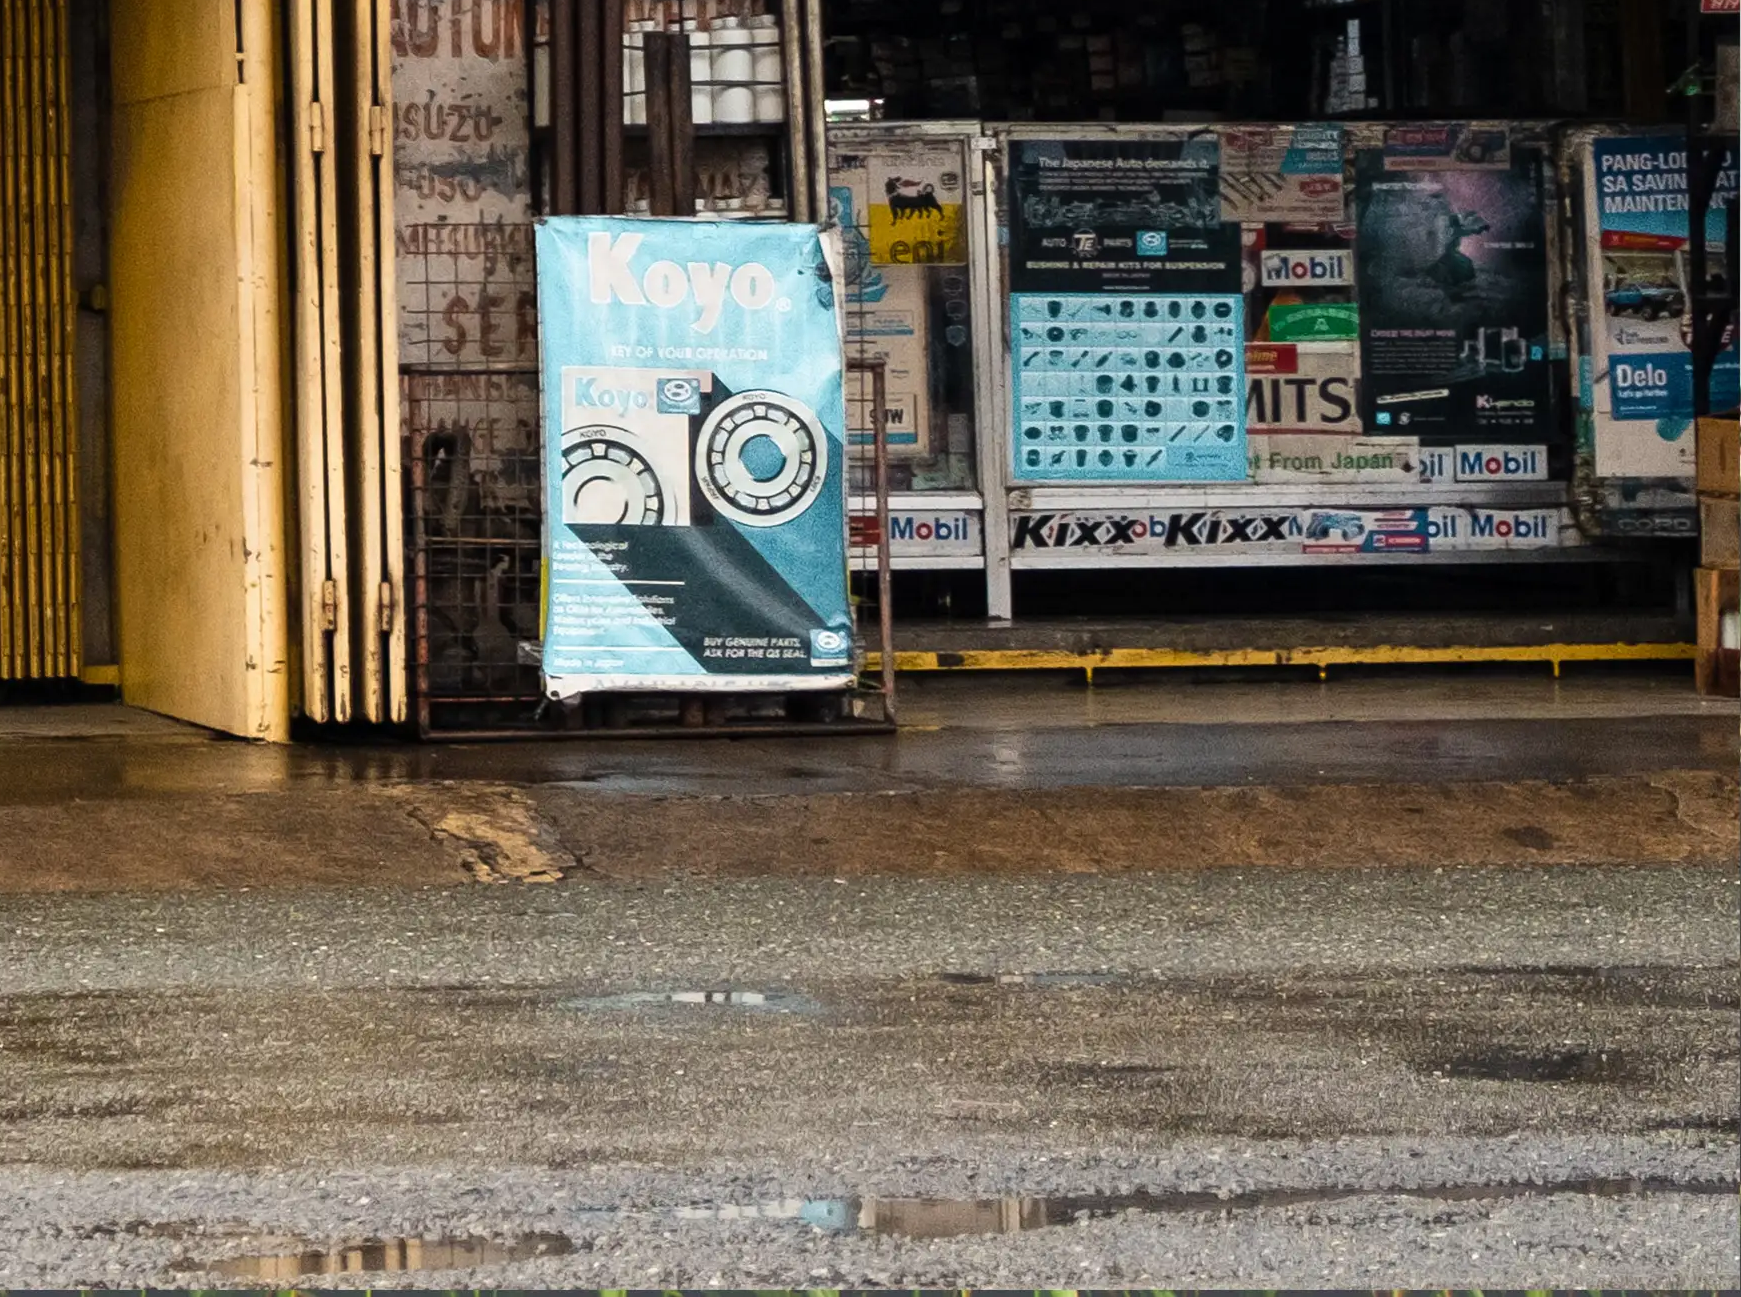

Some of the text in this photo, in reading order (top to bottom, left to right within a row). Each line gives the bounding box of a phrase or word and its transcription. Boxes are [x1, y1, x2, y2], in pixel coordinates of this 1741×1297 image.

[1039, 157, 1060, 170] The
[1062, 157, 1112, 170] Japanese
[1116, 157, 1141, 170] Auto
[1145, 157, 1197, 170] demands
[1602, 175, 1628, 192] SA
[1042, 238, 1067, 247] AUTO
[1104, 238, 1132, 247] PARTS
[1026, 261, 1070, 269] BUSHING
[1082, 261, 1115, 269] REPAIR
[1118, 261, 1141, 269] KITS
[1144, 261, 1162, 269] FOR
[1165, 261, 1226, 269] SUSPENSION
[1267, 255, 1343, 280] Mobil
[587, 231, 776, 334] Koyo
[1617, 362, 1667, 387] Delo
[574, 376, 649, 418] Koyo
[1269, 452, 1393, 472] From Japan
[1461, 452, 1536, 475] Mobil
[890, 517, 968, 541] Mobil
[1013, 512, 1138, 548] Kixx
[1164, 511, 1291, 545] Kixx
[1471, 513, 1547, 538] Mobil
[704, 637, 722, 647] BUY
[725, 637, 768, 647] GENUINE
[704, 649, 722, 658] ASK
[725, 649, 745, 658] FOR
[747, 649, 764, 658] THE
